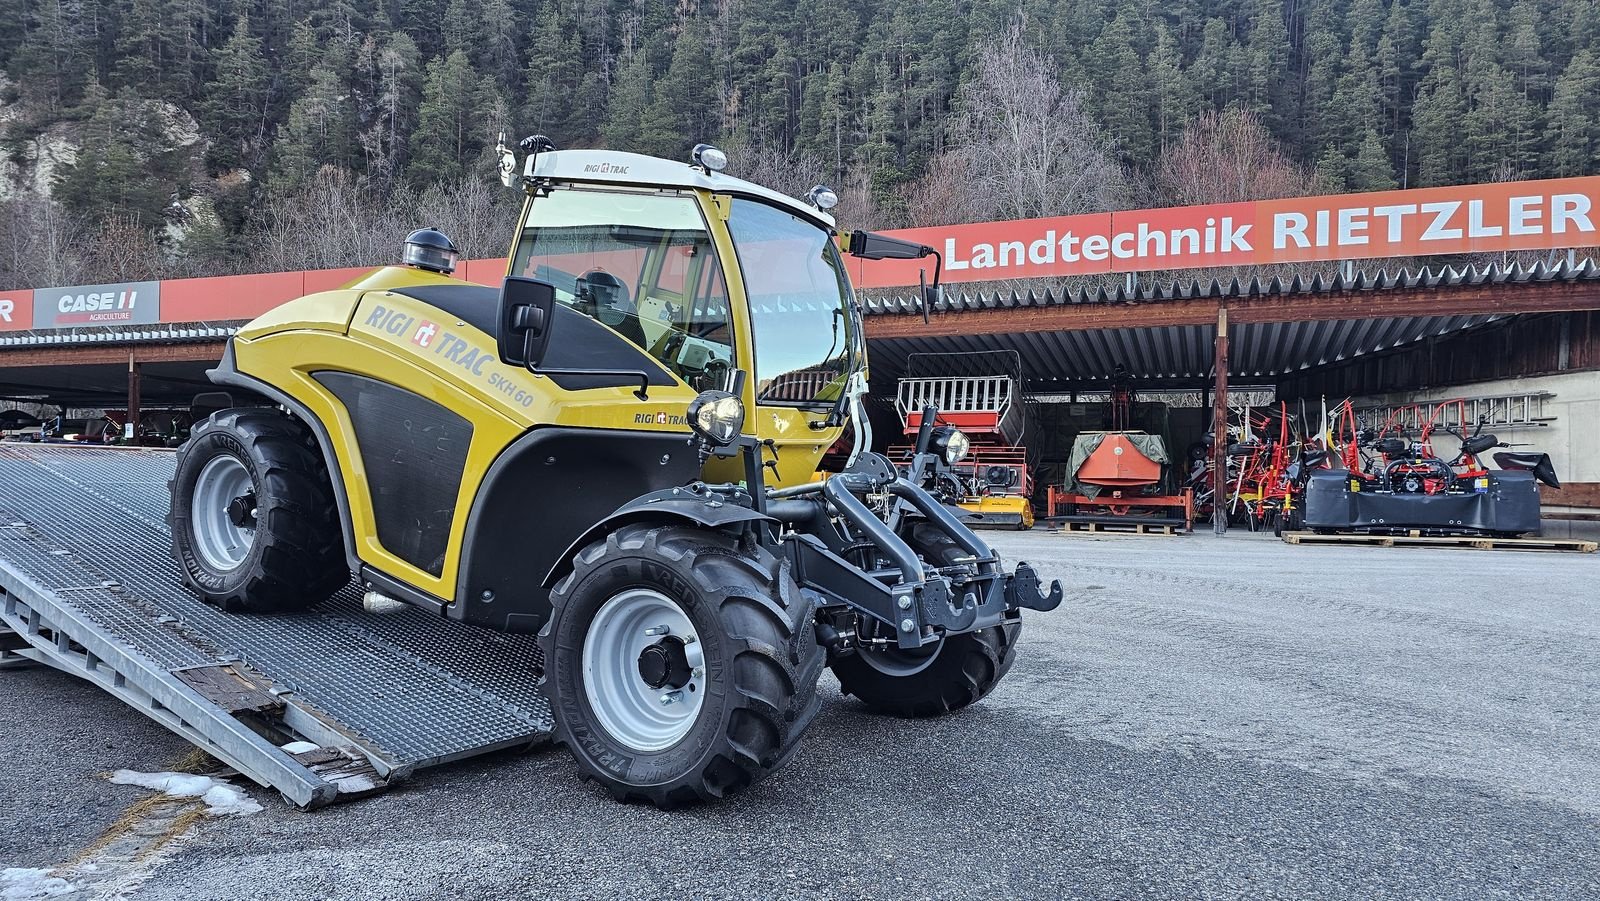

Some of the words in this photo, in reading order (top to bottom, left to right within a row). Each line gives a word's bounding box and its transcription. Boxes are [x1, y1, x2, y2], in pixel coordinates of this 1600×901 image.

[584, 164, 600, 173] RIGI
[610, 165, 629, 175] TRAC
[944, 216, 1254, 272] Landtechnik
[1273, 192, 1595, 250] RIETZLER
[58, 292, 115, 313] CASE
[89, 312, 130, 322] AGRICULTURE
[364, 305, 416, 337] RIGI
[434, 332, 496, 377] TRAC
[487, 372, 516, 397] SKH
[514, 389, 534, 408] 60
[634, 413, 655, 424] RIGI
[182, 549, 224, 589] TRAXION
